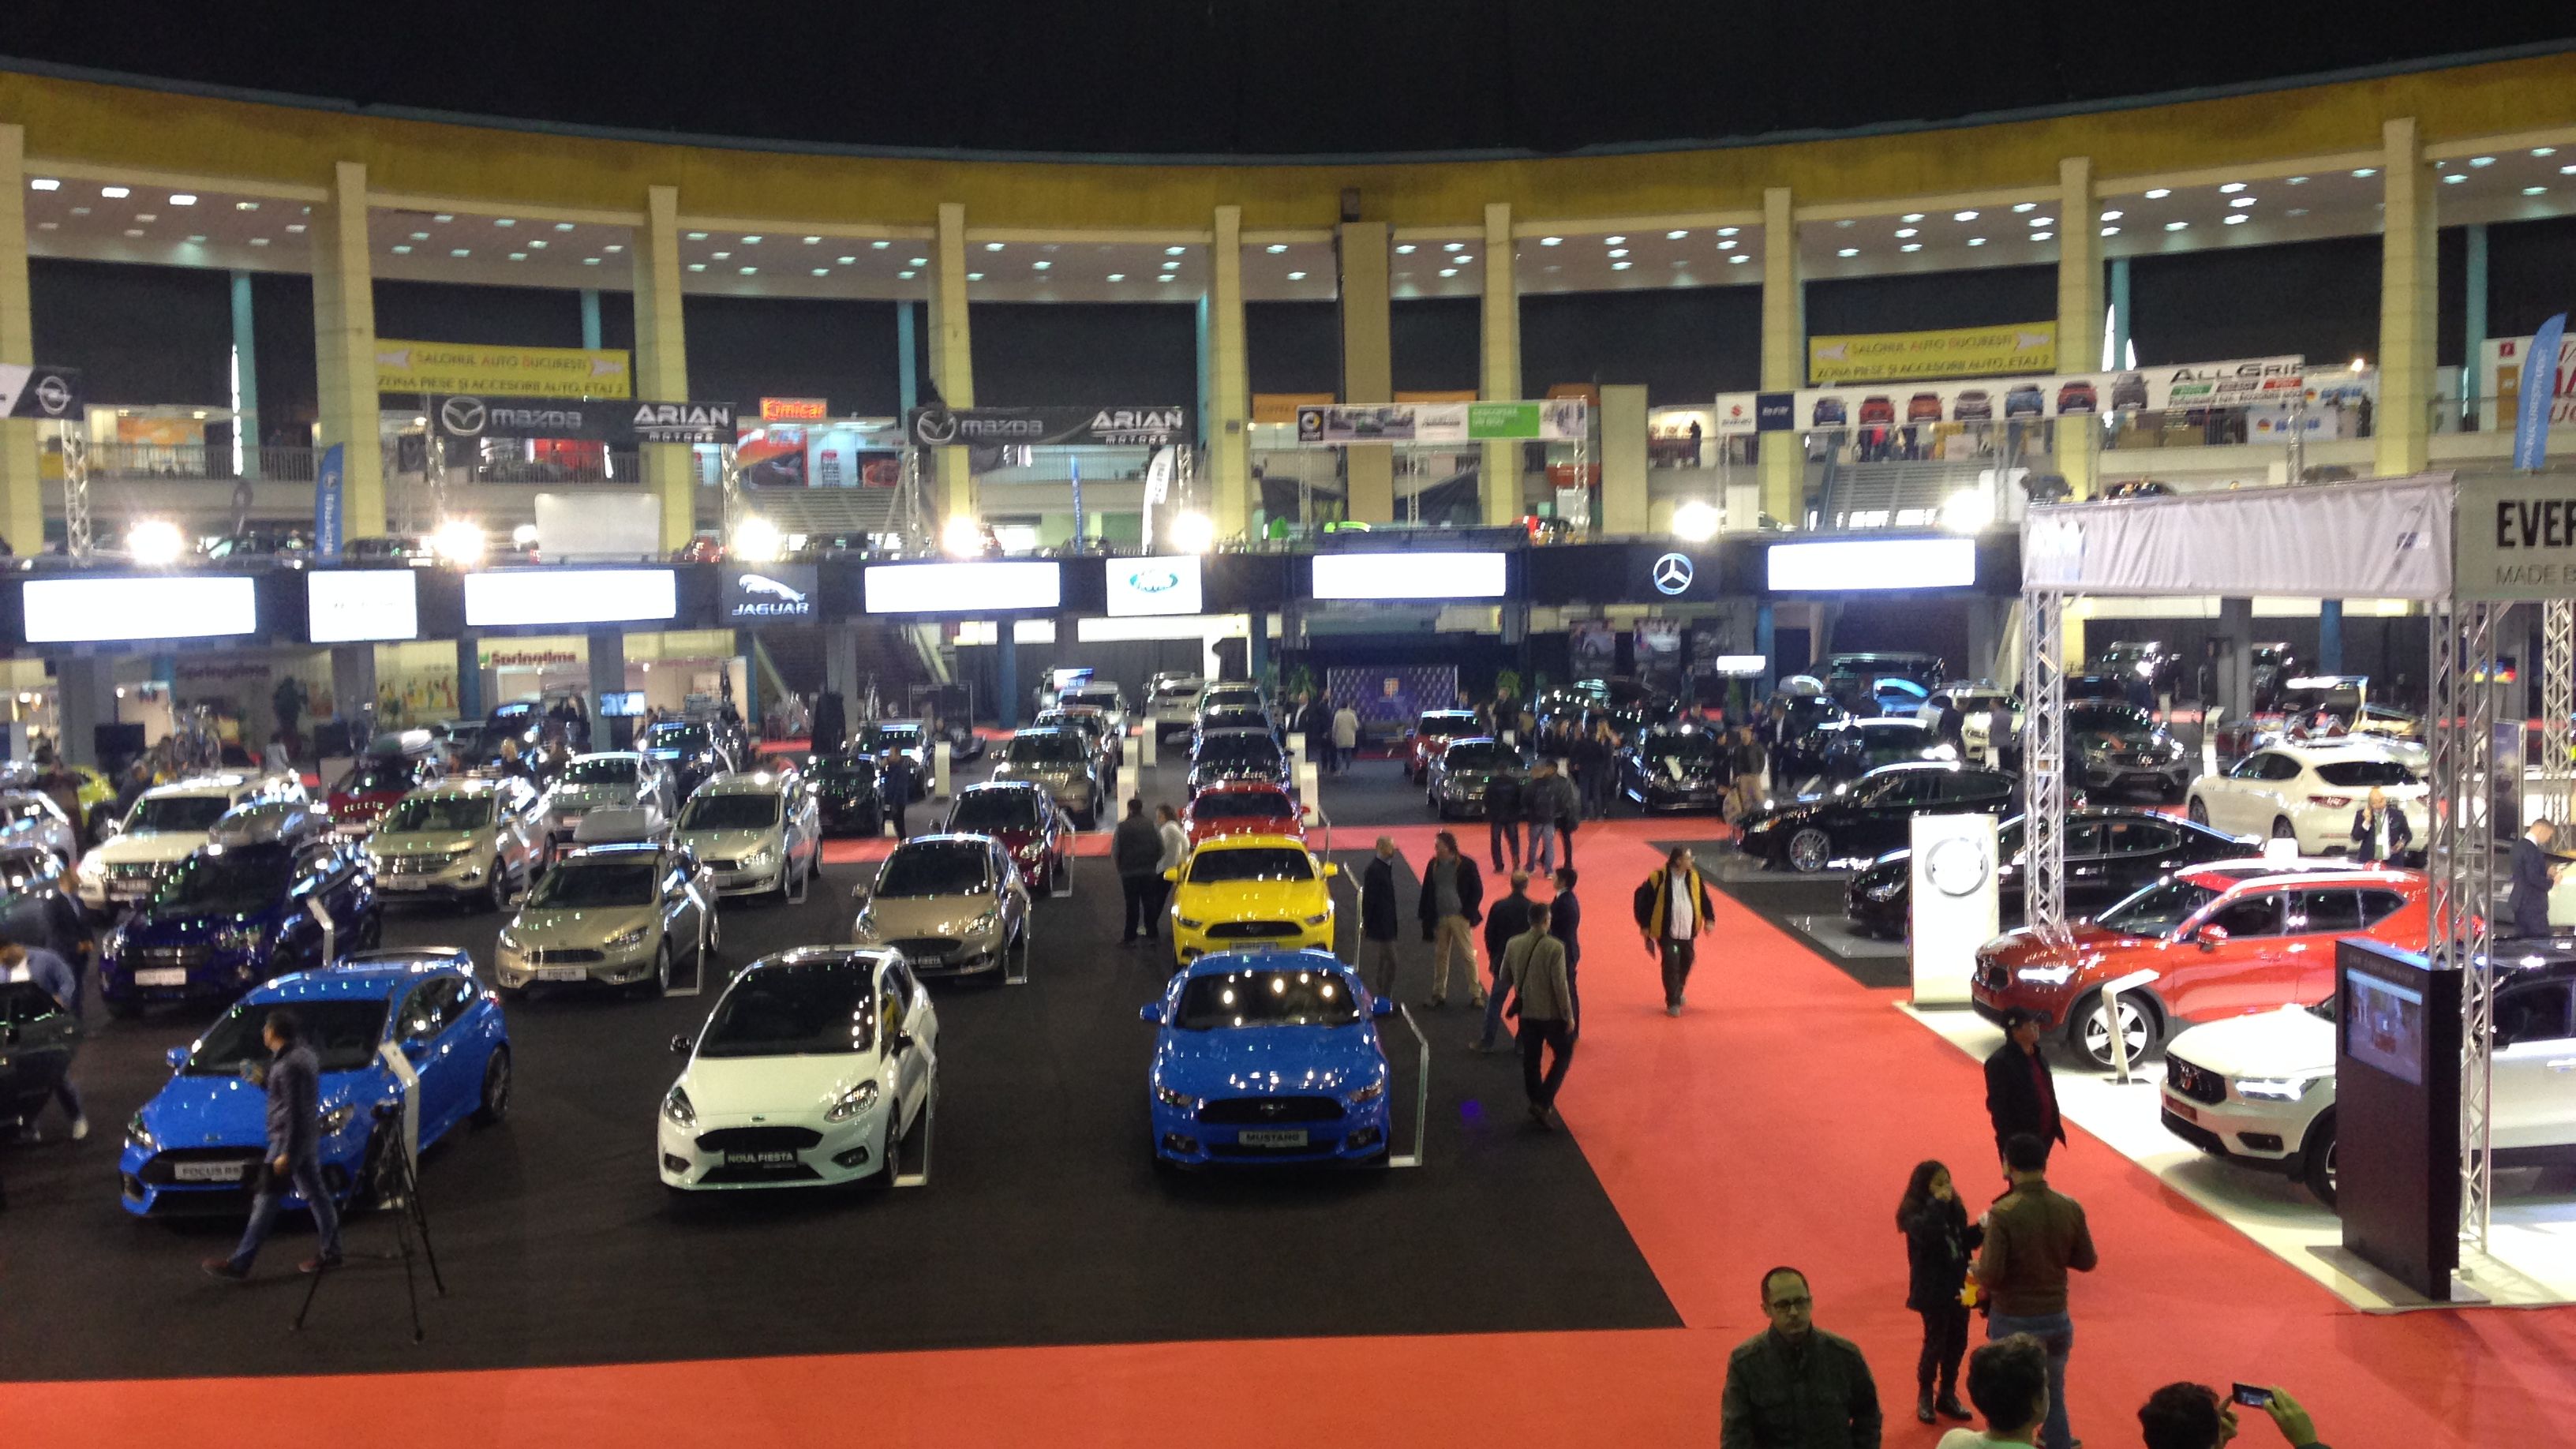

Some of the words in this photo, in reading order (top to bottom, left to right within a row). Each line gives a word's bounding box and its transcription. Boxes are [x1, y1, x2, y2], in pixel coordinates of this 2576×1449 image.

[633, 403, 729, 427] ARIAN
[1091, 410, 1184, 430] ARIAN
[2496, 564, 2559, 586] MADE
[731, 603, 810, 616] JAGUAR
[1247, 1133, 1300, 1142] MUSTANG
[727, 1153, 756, 1163] NOUL
[758, 1153, 794, 1163] FIESTA
[182, 1167, 222, 1176] FOCUS
